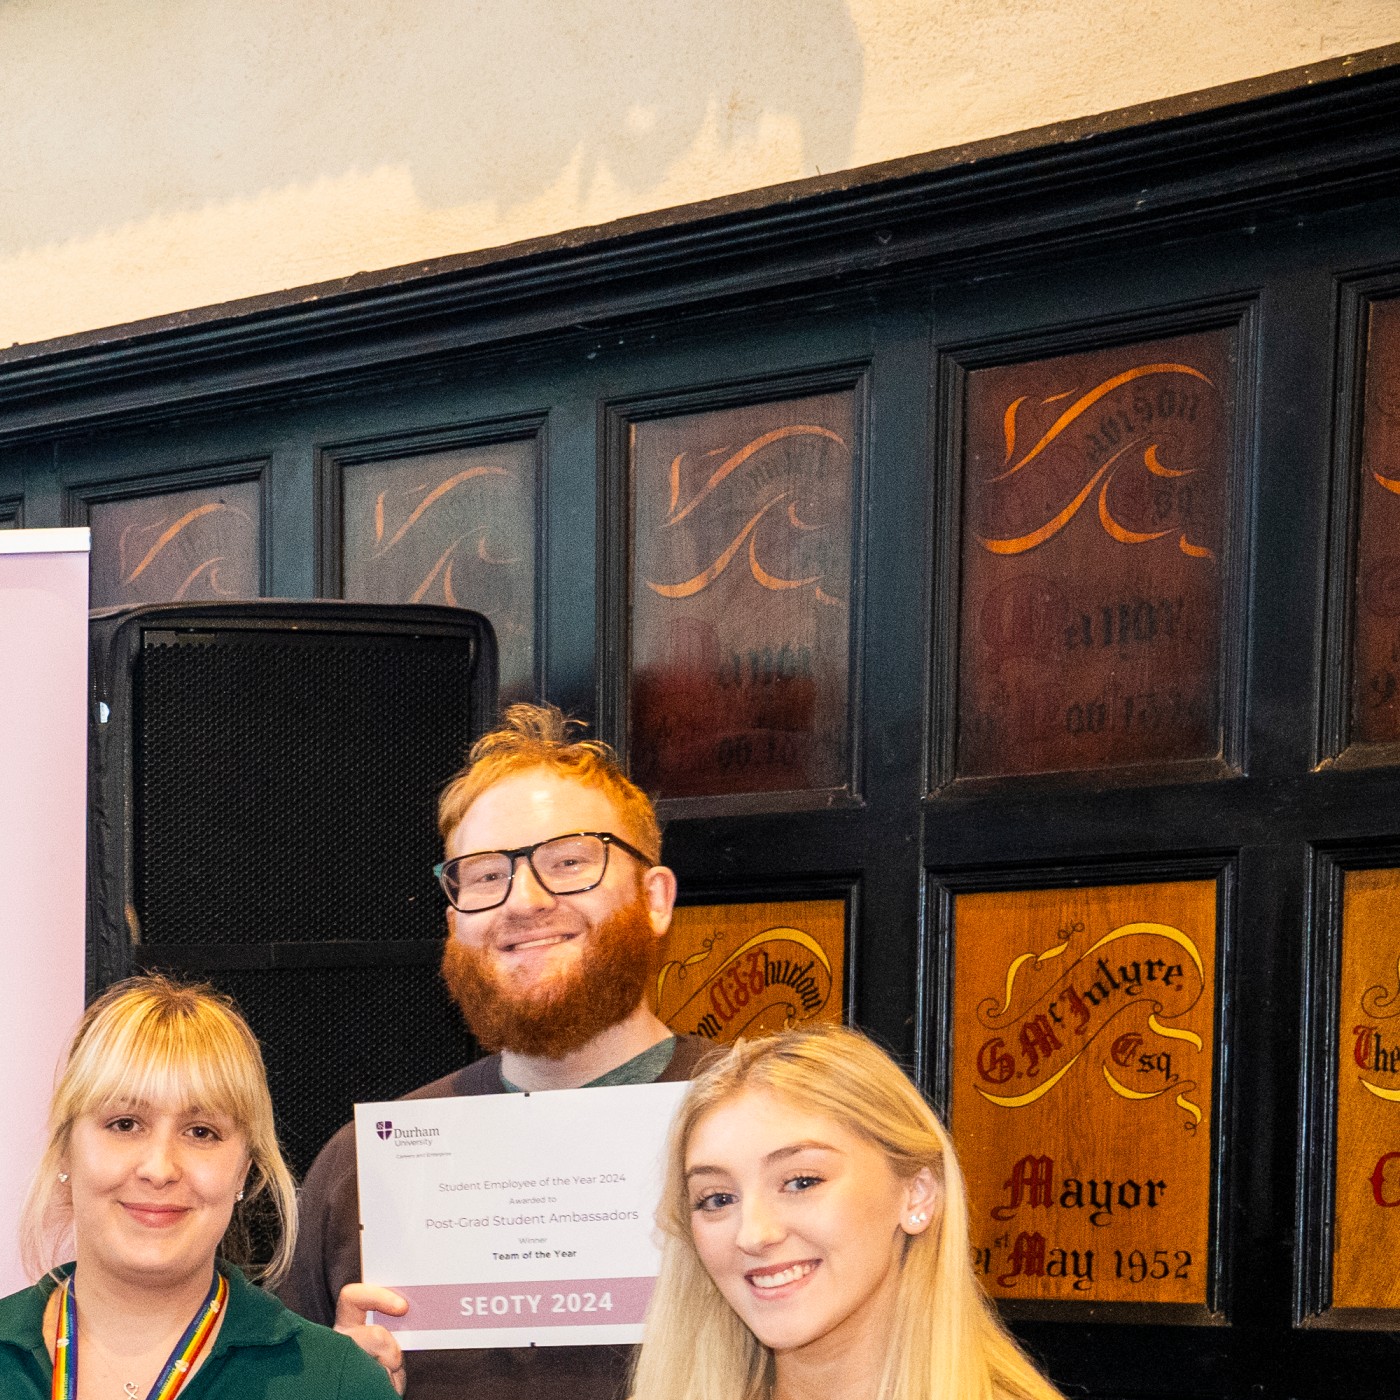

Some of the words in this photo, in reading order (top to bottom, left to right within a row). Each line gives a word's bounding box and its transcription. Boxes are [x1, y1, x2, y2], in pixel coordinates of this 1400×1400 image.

[395, 1127, 439, 1138] Durham
[439, 1183, 480, 1192] Student
[484, 1180, 536, 1189] Employee
[540, 1177, 549, 1186] of
[600, 1174, 626, 1183] 2024
[990, 1153, 1167, 1226] Mayor
[426, 1217, 489, 1228] Post-Grad
[493, 1215, 545, 1226] Student
[549, 1210, 639, 1222] Ambassadors
[523, 1251, 532, 1259] of
[998, 1230, 1095, 1290] May
[1113, 1248, 1192, 1283] 1952
[461, 1295, 541, 1316] SEOTY
[552, 1292, 613, 1312] 2024
